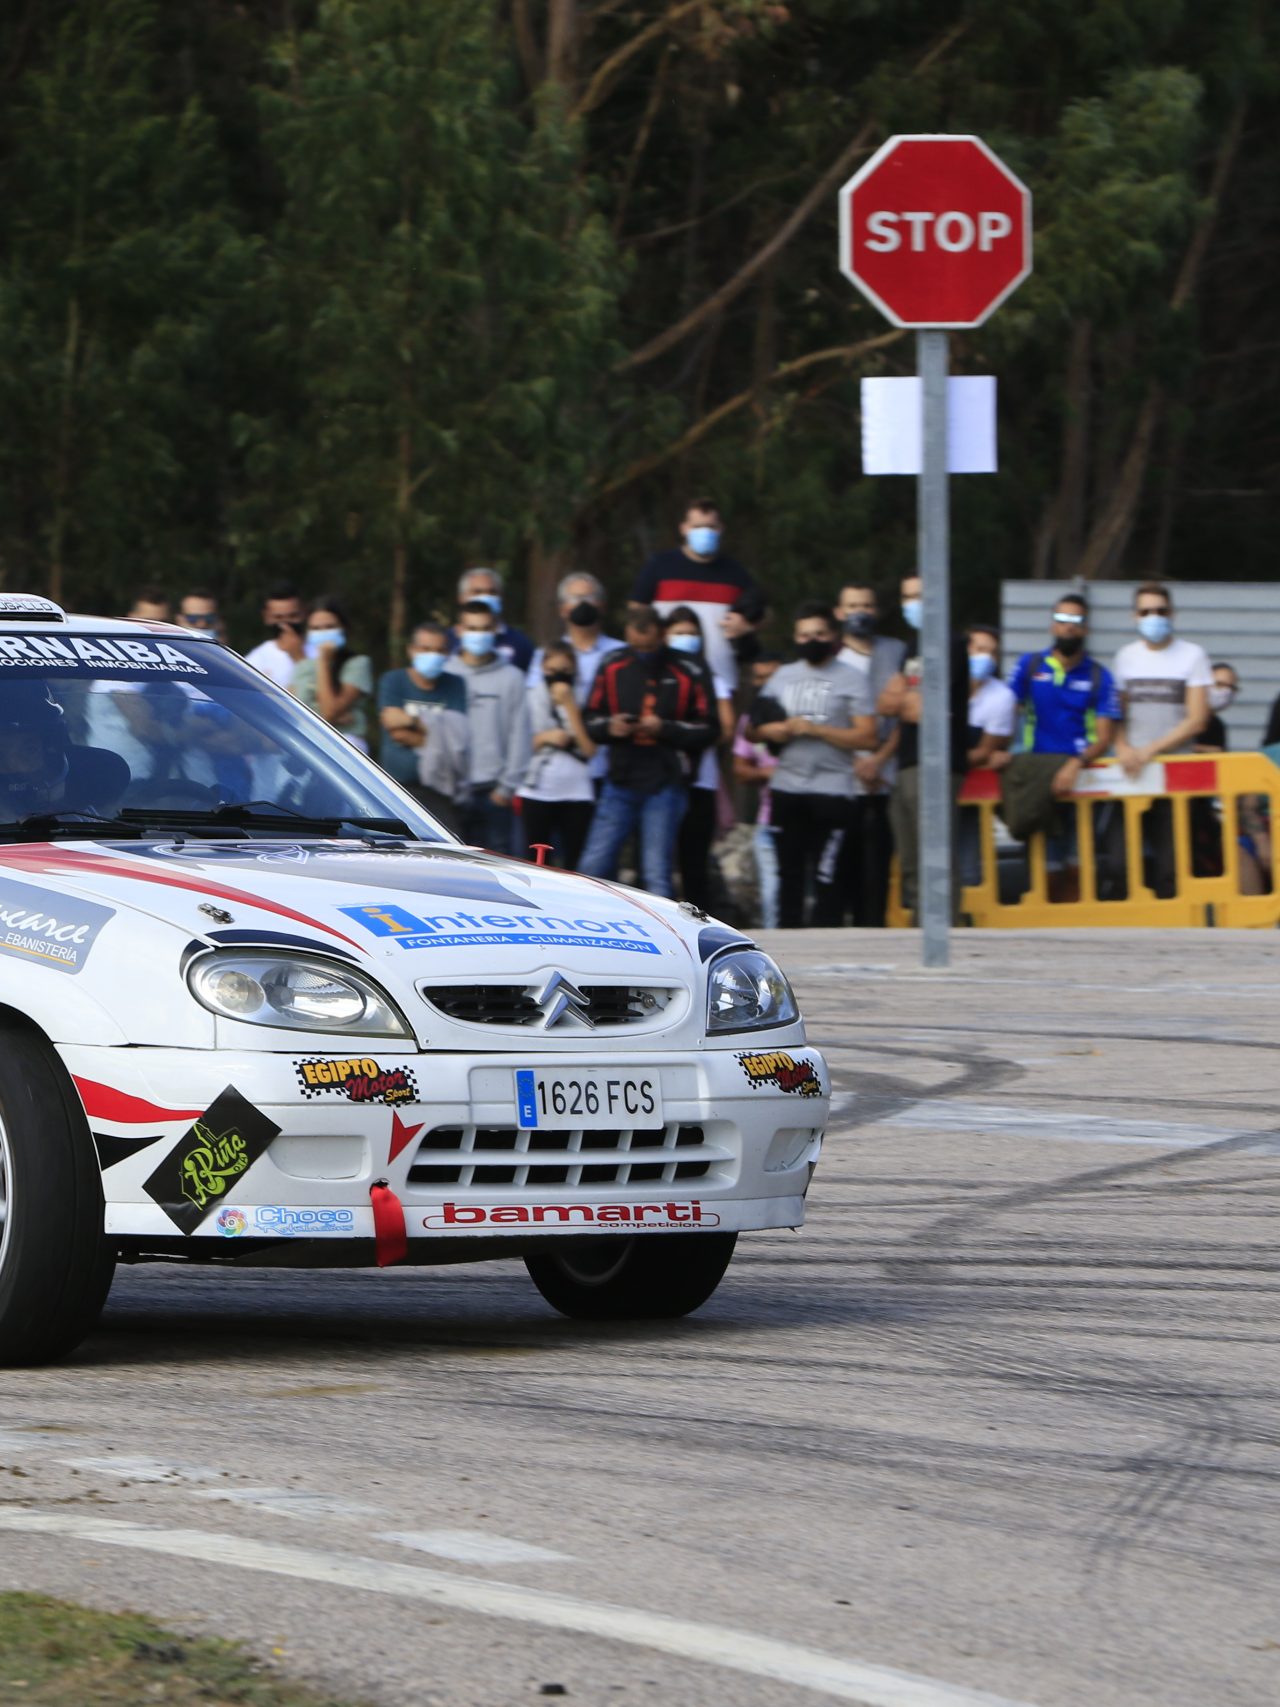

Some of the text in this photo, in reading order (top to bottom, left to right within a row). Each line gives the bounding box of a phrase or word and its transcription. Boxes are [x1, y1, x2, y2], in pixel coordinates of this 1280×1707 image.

[864, 211, 1012, 252] STOP
[83, 659, 209, 675] INMOBILIARIAS
[6, 932, 78, 962] EBANISTERÍA
[527, 935, 651, 952] CLIMATIZACIÓN
[302, 1057, 378, 1084] EGIPTO
[742, 1051, 795, 1076] EGIPTO
[345, 1071, 405, 1099] Motor
[384, 1088, 411, 1101] Sport
[537, 1080, 655, 1115] 1626 FCS
[523, 1105, 532, 1118] E
[256, 1206, 353, 1224] Choco
[443, 1200, 702, 1223] bamarti
